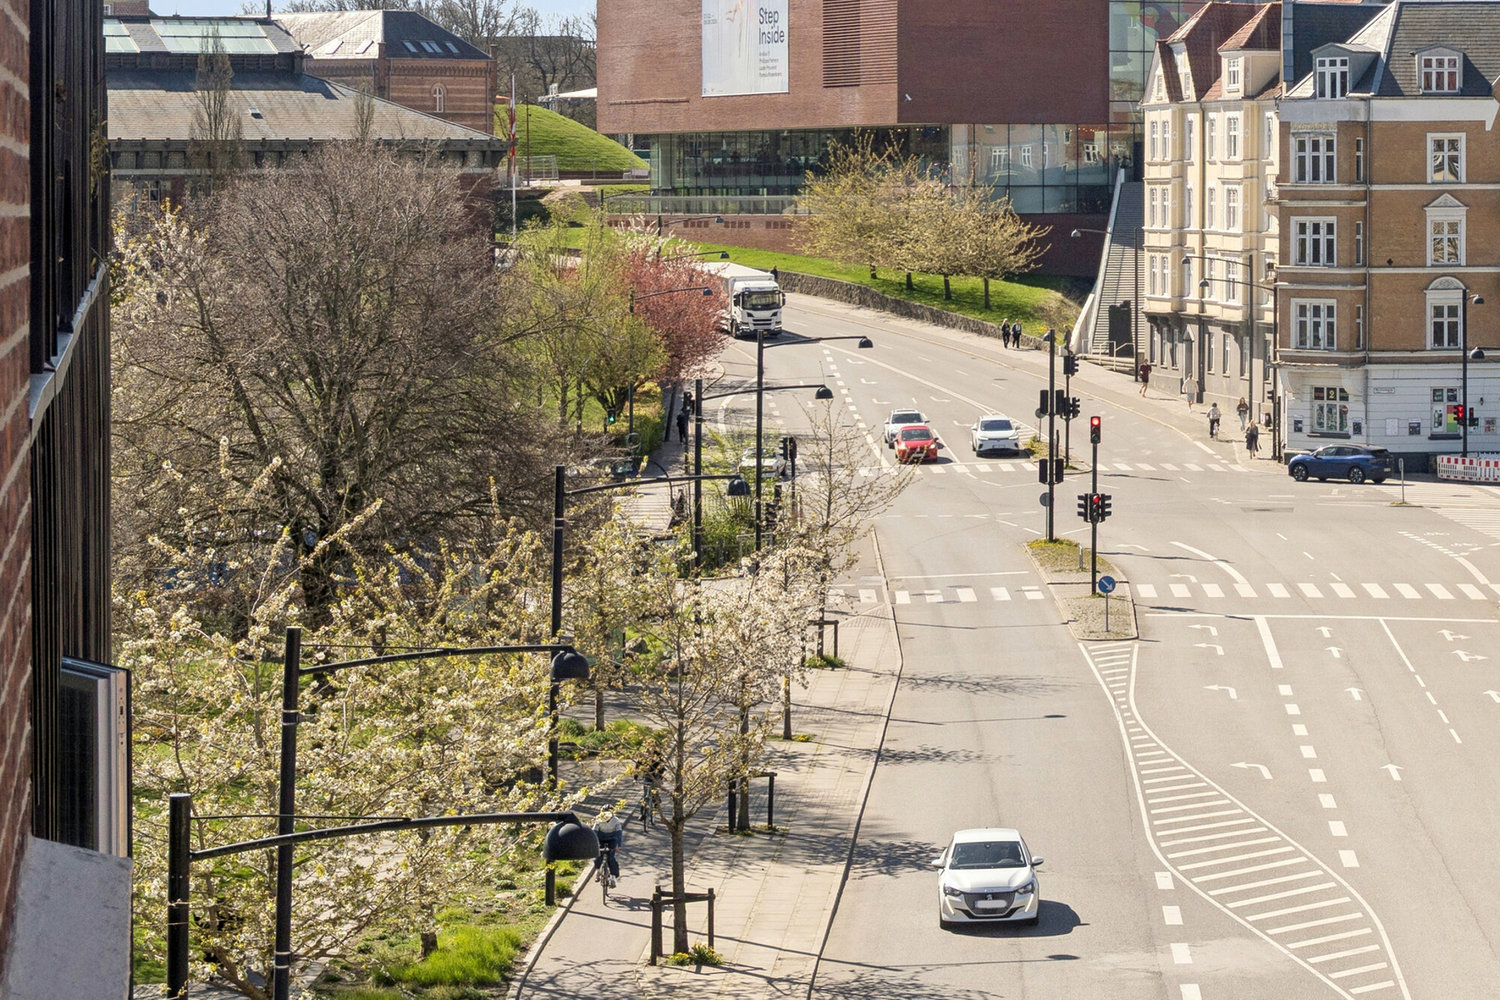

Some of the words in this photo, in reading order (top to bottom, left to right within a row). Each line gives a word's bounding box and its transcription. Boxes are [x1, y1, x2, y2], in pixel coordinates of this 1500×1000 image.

[759, 7, 779, 27] Step
[759, 26, 785, 44] Inside
[1329, 390, 1335, 399] 2
